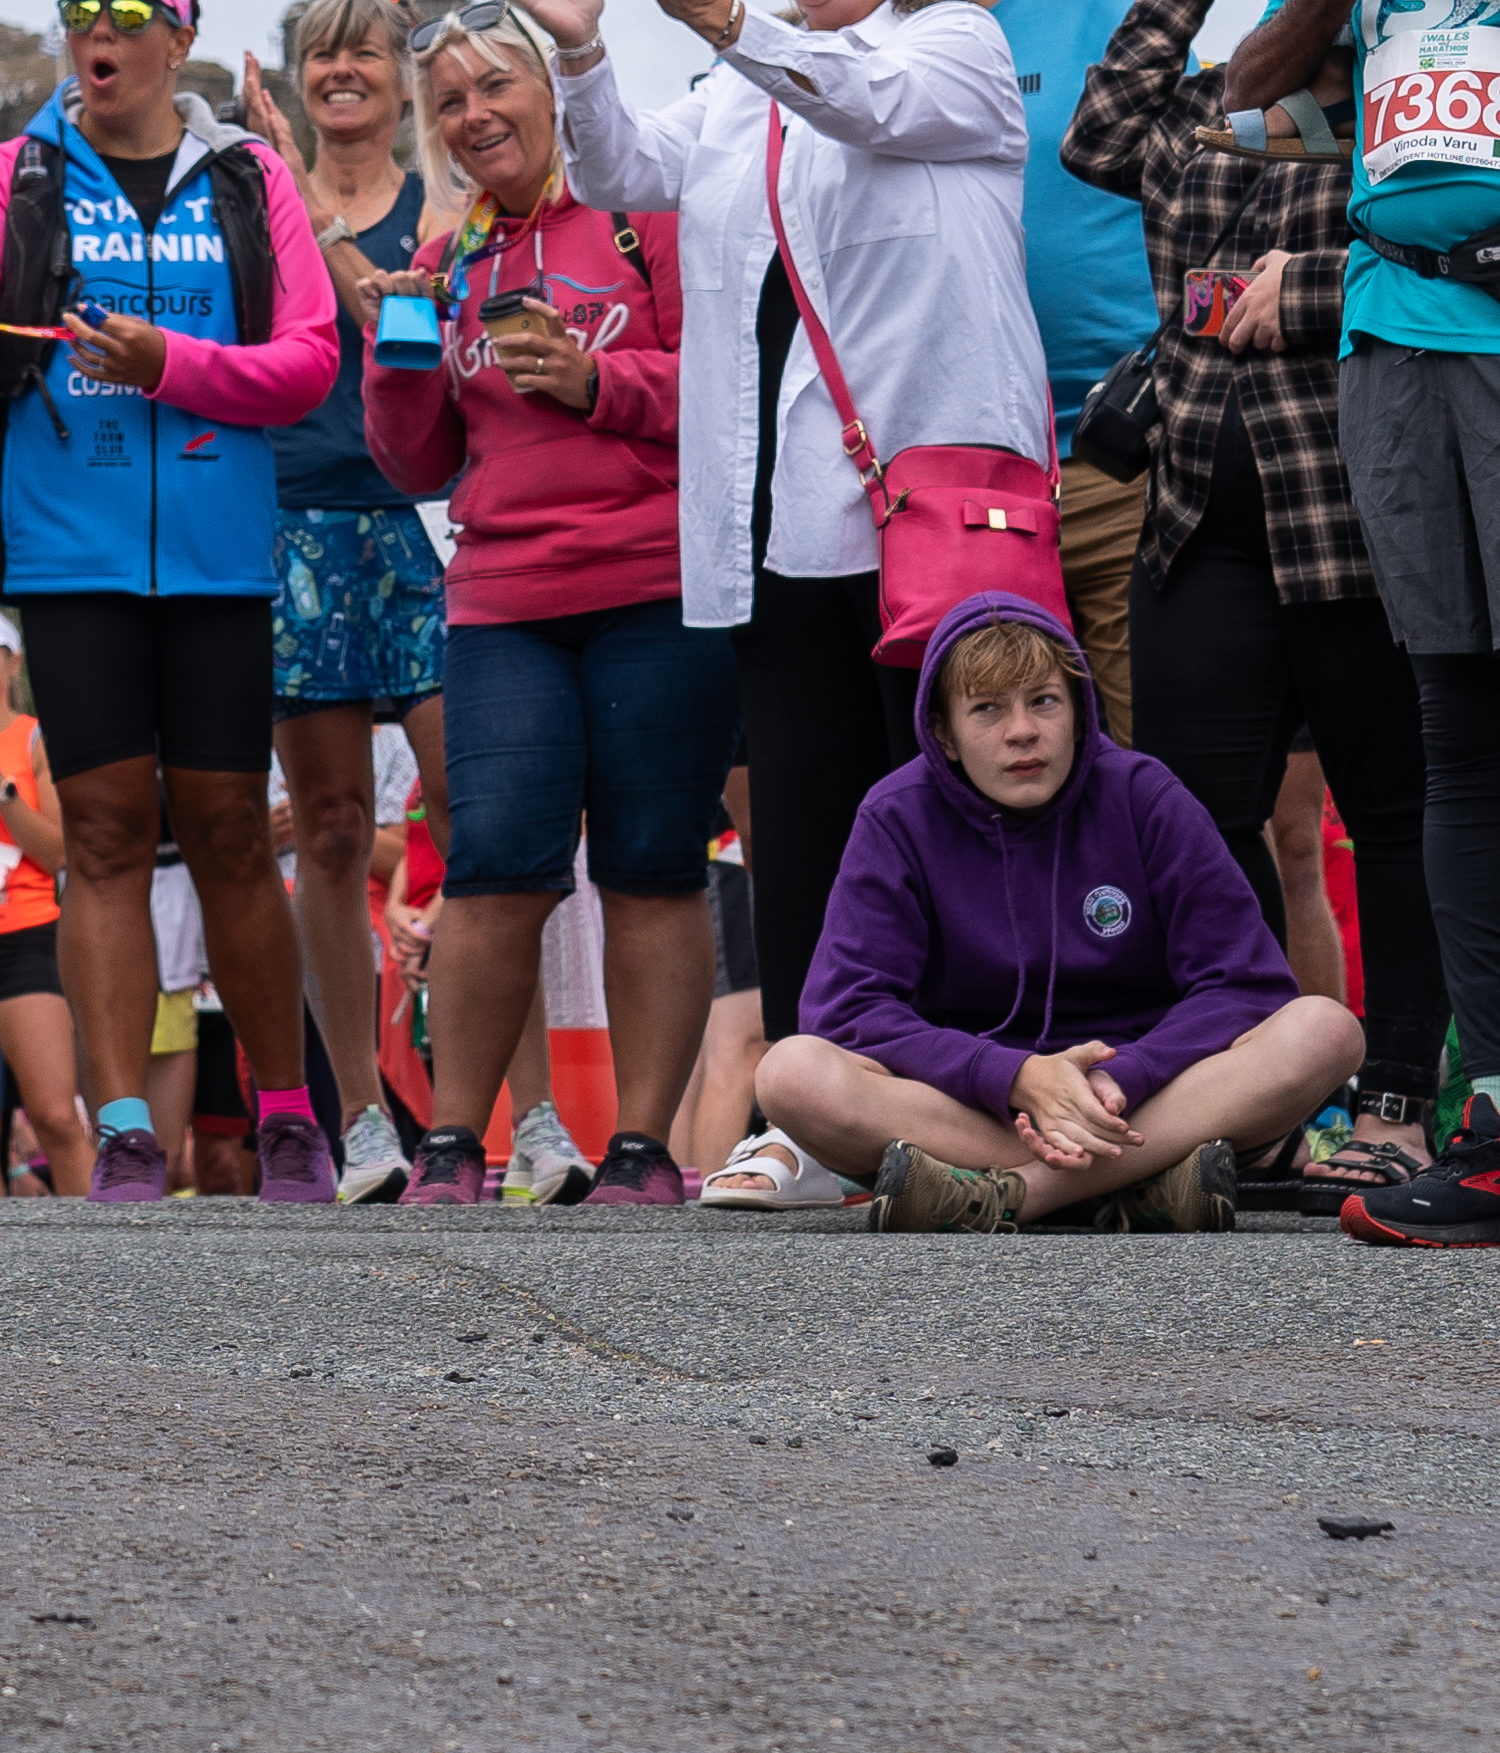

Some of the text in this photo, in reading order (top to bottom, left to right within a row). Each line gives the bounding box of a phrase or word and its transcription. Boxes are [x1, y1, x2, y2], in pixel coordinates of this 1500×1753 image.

[1426, 31, 1470, 42] WALES
[1393, 135, 1478, 154] Vinoda Varu
[1426, 152, 1464, 163] HOTLINE
[72, 232, 224, 263] RAININ
